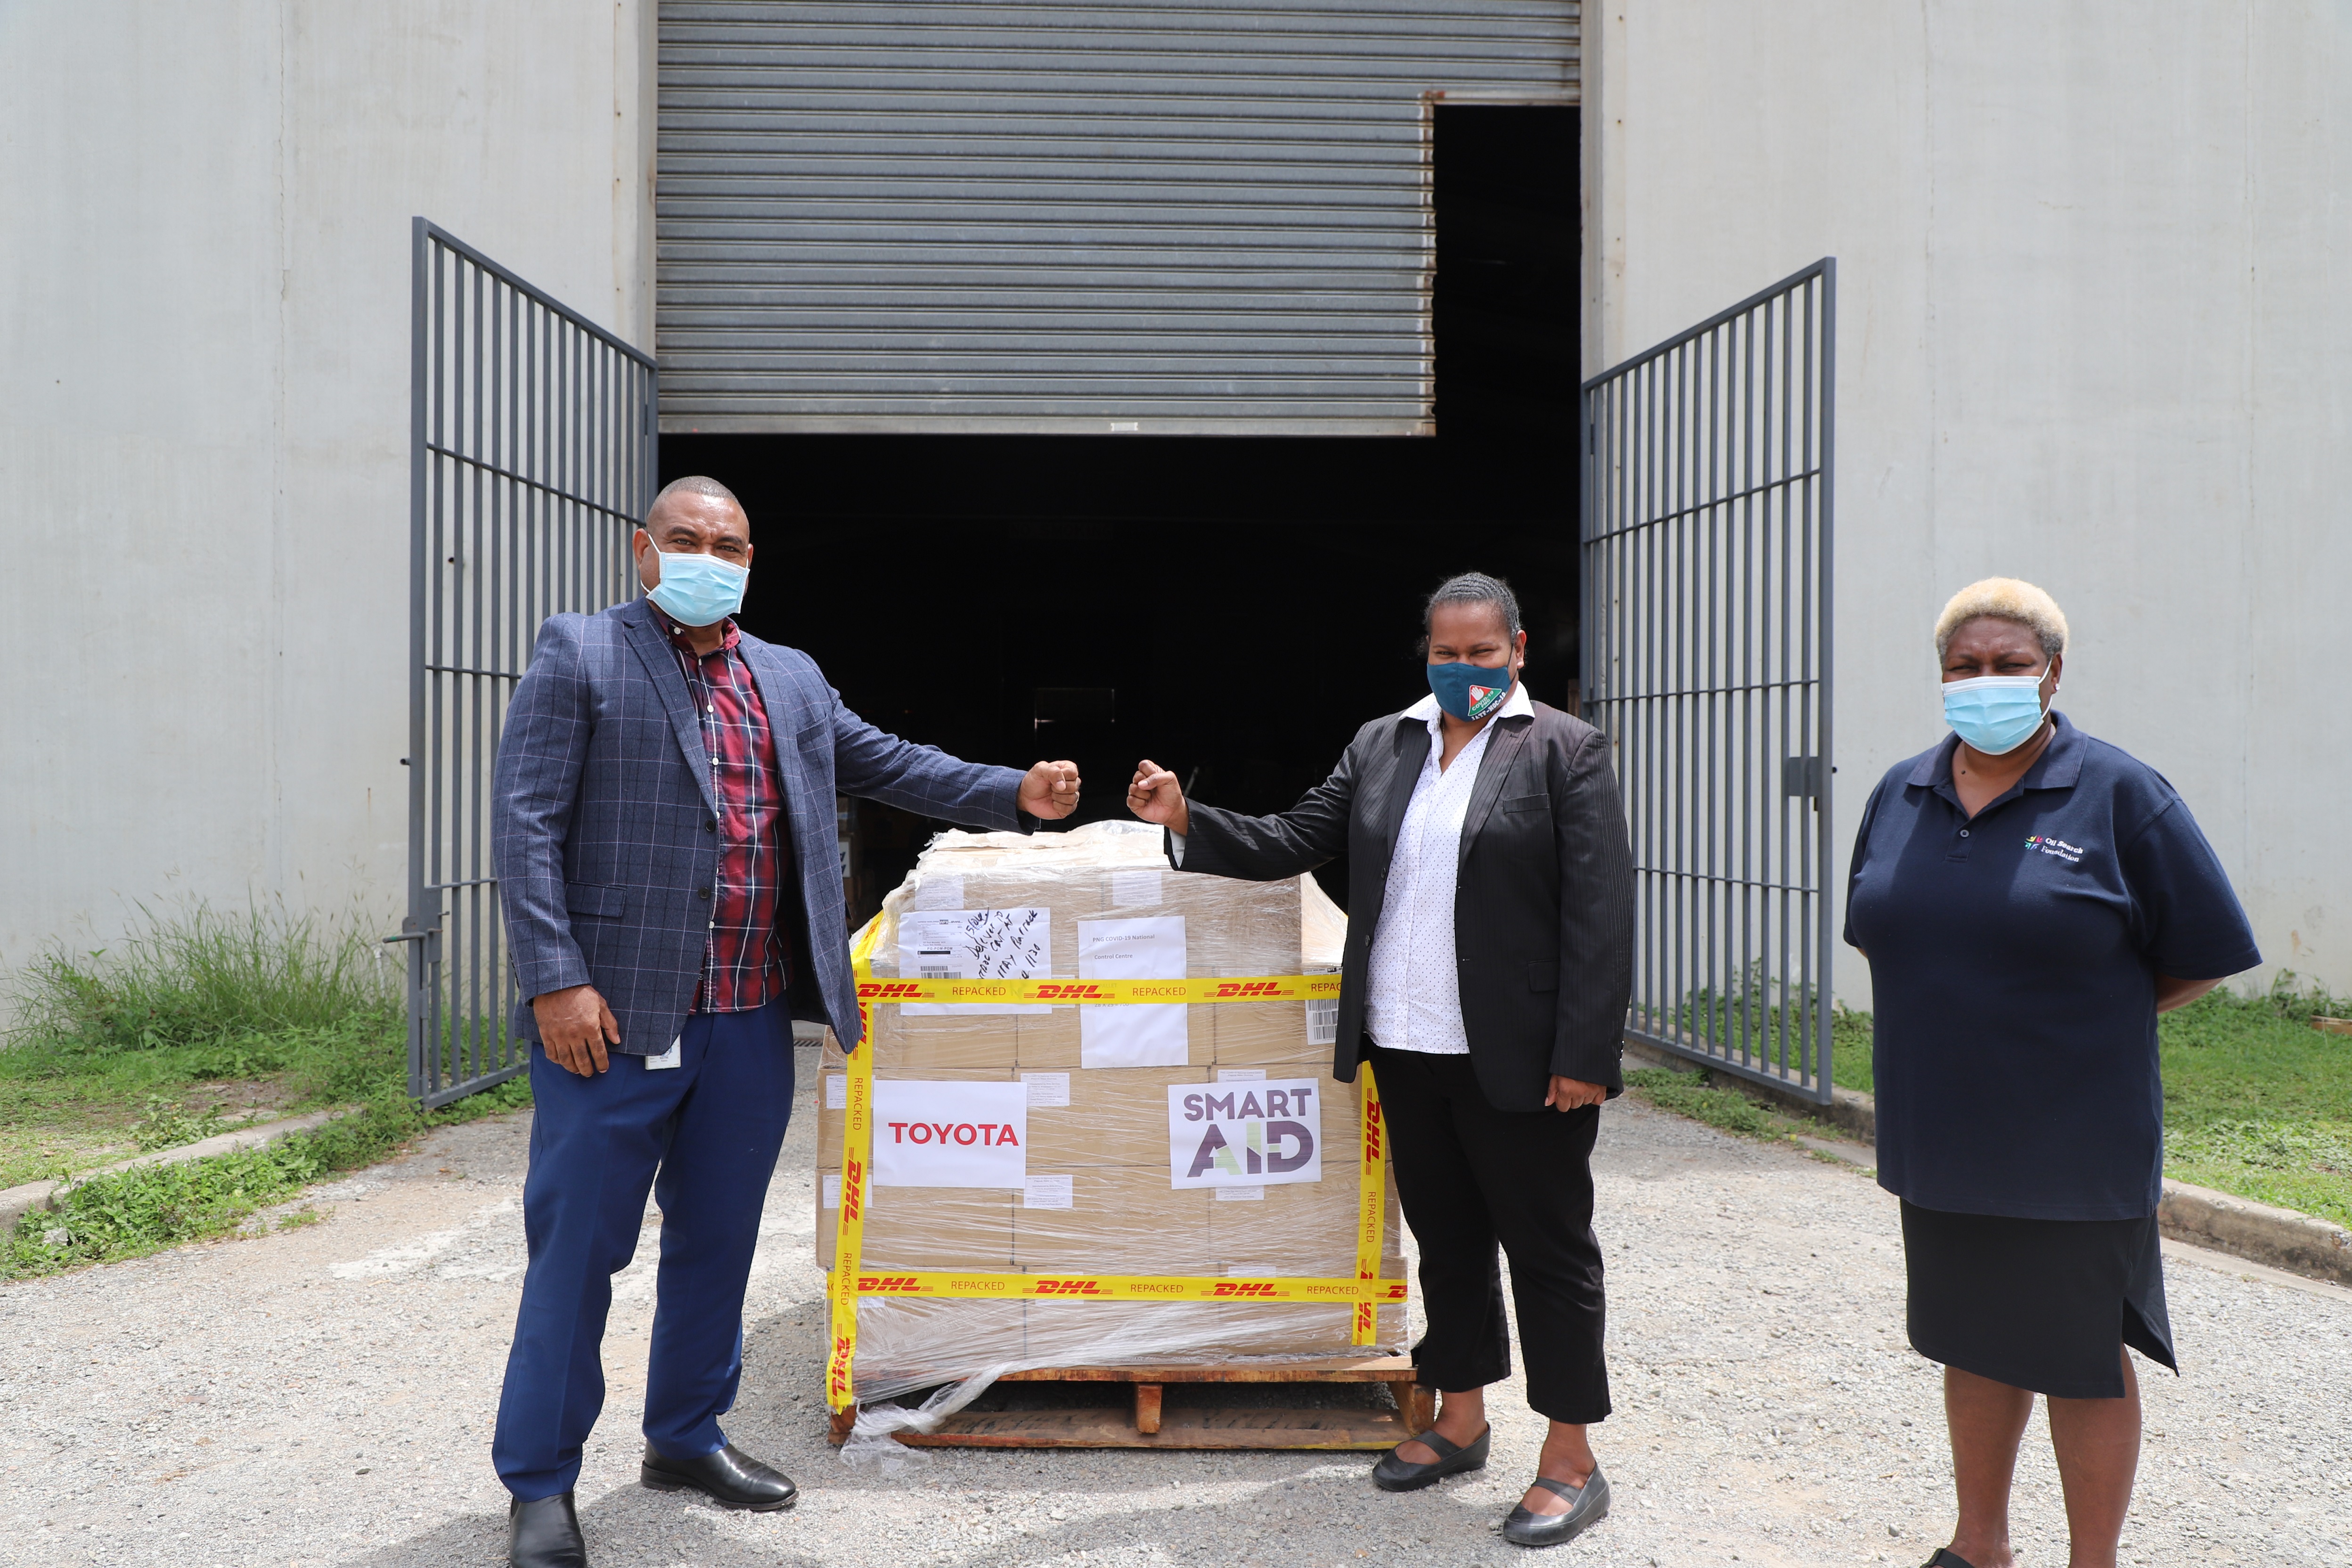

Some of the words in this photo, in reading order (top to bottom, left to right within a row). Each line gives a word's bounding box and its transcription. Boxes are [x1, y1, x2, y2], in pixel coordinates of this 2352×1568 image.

[1472, 691, 1494, 711] COVID-19
[1481, 699, 1490, 708] PNG
[2045, 837, 2057, 847] Oil
[2057, 841, 2083, 854] Search
[2041, 845, 2079, 862] Foundation
[858, 984, 923, 997] DHL
[952, 987, 1006, 996] REPACKED
[1036, 985, 1103, 998] DHL
[1132, 987, 1186, 996] REPACKED
[1216, 982, 1282, 997] DHL
[1311, 982, 1341, 992] REPAC
[853, 1078, 863, 1130] REPACKED
[1184, 1088, 1312, 1121] SMART
[888, 1122, 1019, 1146] TOYOTA
[1366, 1100, 1380, 1163] DHL
[1186, 1120, 1314, 1178] AID
[844, 1159, 861, 1224] DHL
[1366, 1192, 1376, 1243] REPACKED
[841, 1253, 852, 1306] REPACKED
[858, 1278, 921, 1291] DHL
[951, 1281, 1005, 1290] REPACKED
[1034, 1280, 1101, 1294] DHL
[1131, 1284, 1184, 1293] REPACKED
[1213, 1283, 1278, 1296] DHL
[1307, 1286, 1359, 1295] REPACKED
[832, 1336, 850, 1397] DHL
